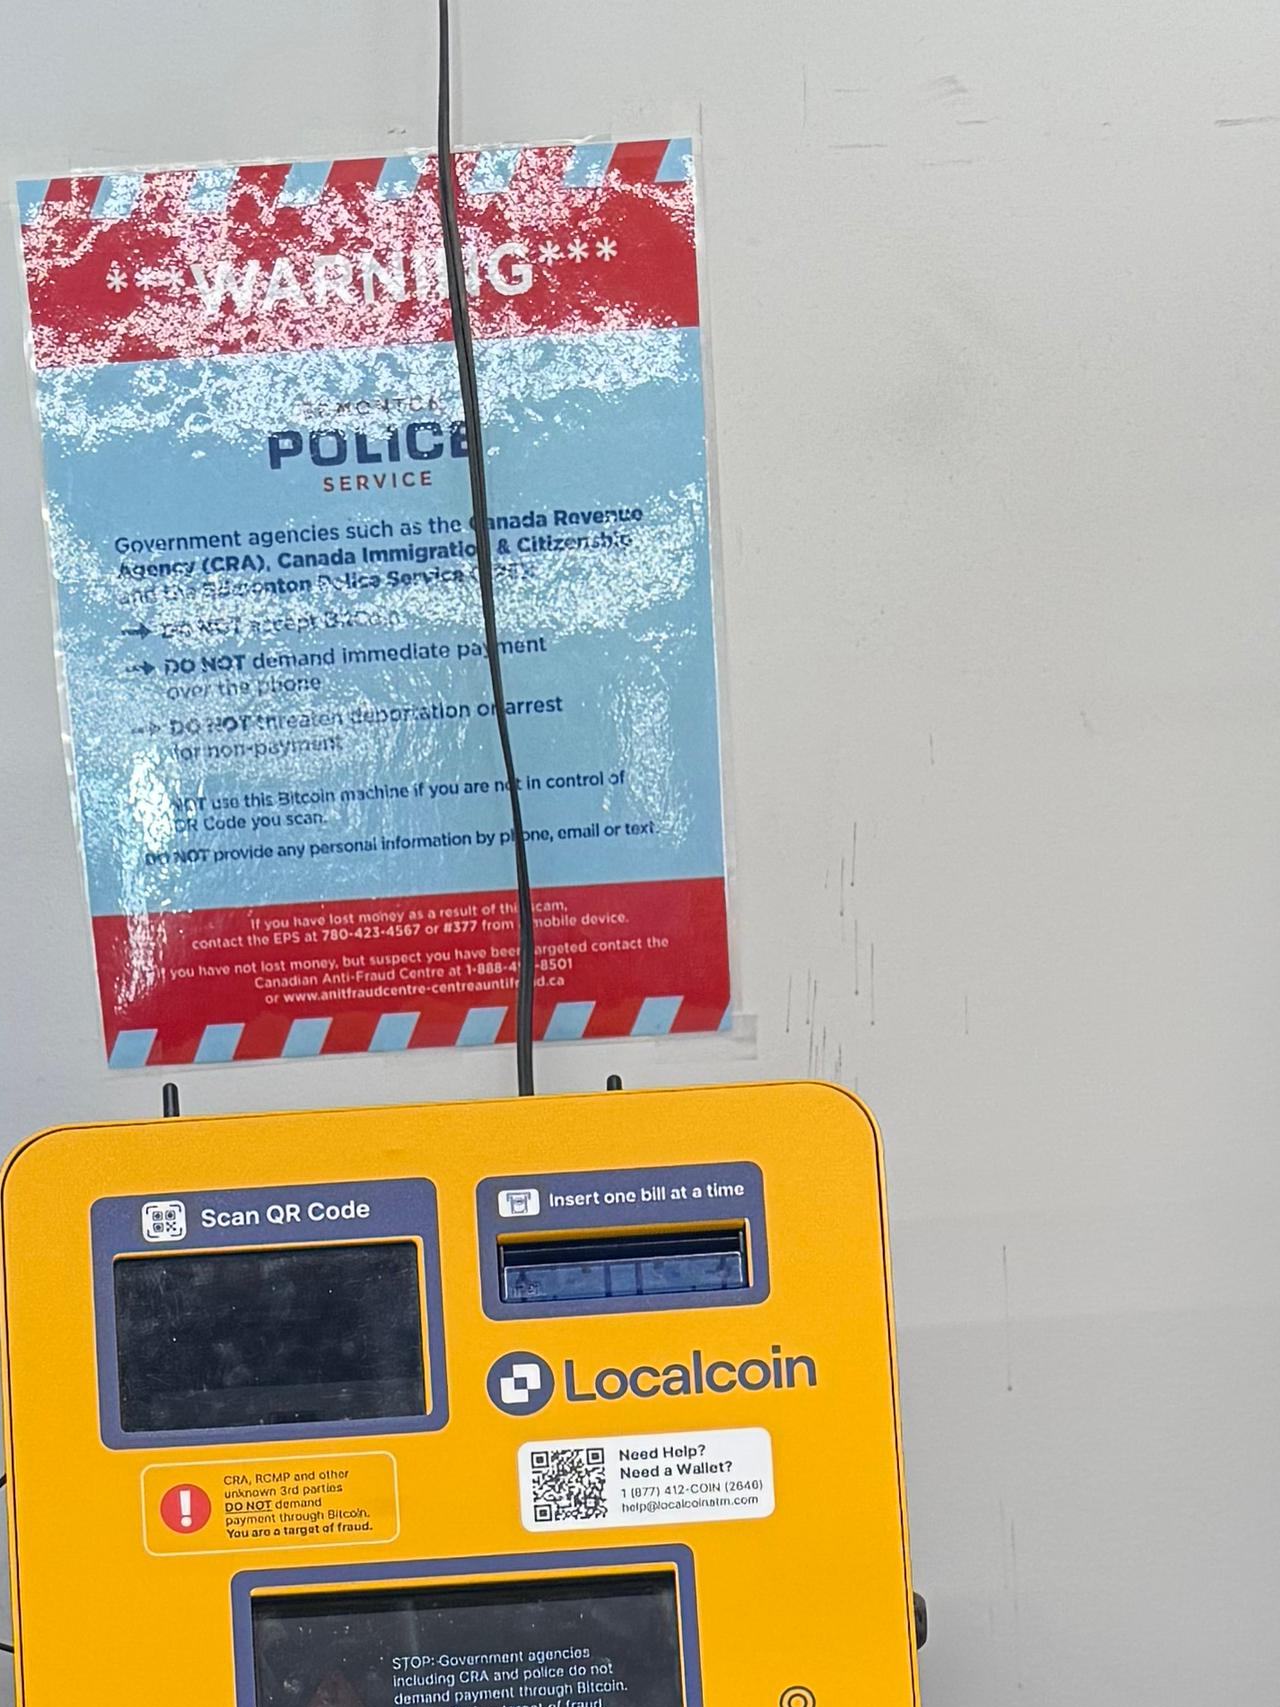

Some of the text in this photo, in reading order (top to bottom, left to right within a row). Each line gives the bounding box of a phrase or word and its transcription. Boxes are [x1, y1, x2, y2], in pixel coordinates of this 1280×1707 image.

[268, 421, 470, 469] POLICE
[324, 471, 432, 492] SERVICE
[115, 518, 462, 555] Government agencies such as the
[253, 643, 450, 669] demand immediate
[214, 823, 621, 864] provide any personal information by email or
[192, 936, 243, 950] contact
[248, 934, 270, 946] the
[273, 932, 300, 945] EPS
[304, 931, 318, 943] at
[322, 924, 420, 941] 780-423-4567
[425, 925, 438, 935] or
[443, 920, 477, 933] #377
[481, 919, 514, 931] from
[581, 912, 629, 925] device.
[255, 966, 444, 989] Canadian Anti-Fraud Centre
[549, 1183, 744, 1207] Insert one bill at a time
[201, 1201, 370, 1228] Scan QR Code
[564, 1344, 818, 1403] Localcoin
[619, 1444, 706, 1461] Need Help?
[620, 1461, 732, 1479] Need a Wallet?
[621, 1488, 626, 1498] 1
[665, 1482, 720, 1495] 412-COIN
[225, 1498, 322, 1512] DO NOT demand
[622, 1495, 758, 1513] help@localcoinatm.com
[227, 1529, 248, 1538] You
[251, 1529, 271, 1537] are
[284, 1524, 319, 1537] target
[322, 1522, 334, 1533] of
[338, 1522, 373, 1532] fraud.
[393, 1662, 613, 1687] including CRA and police do not
